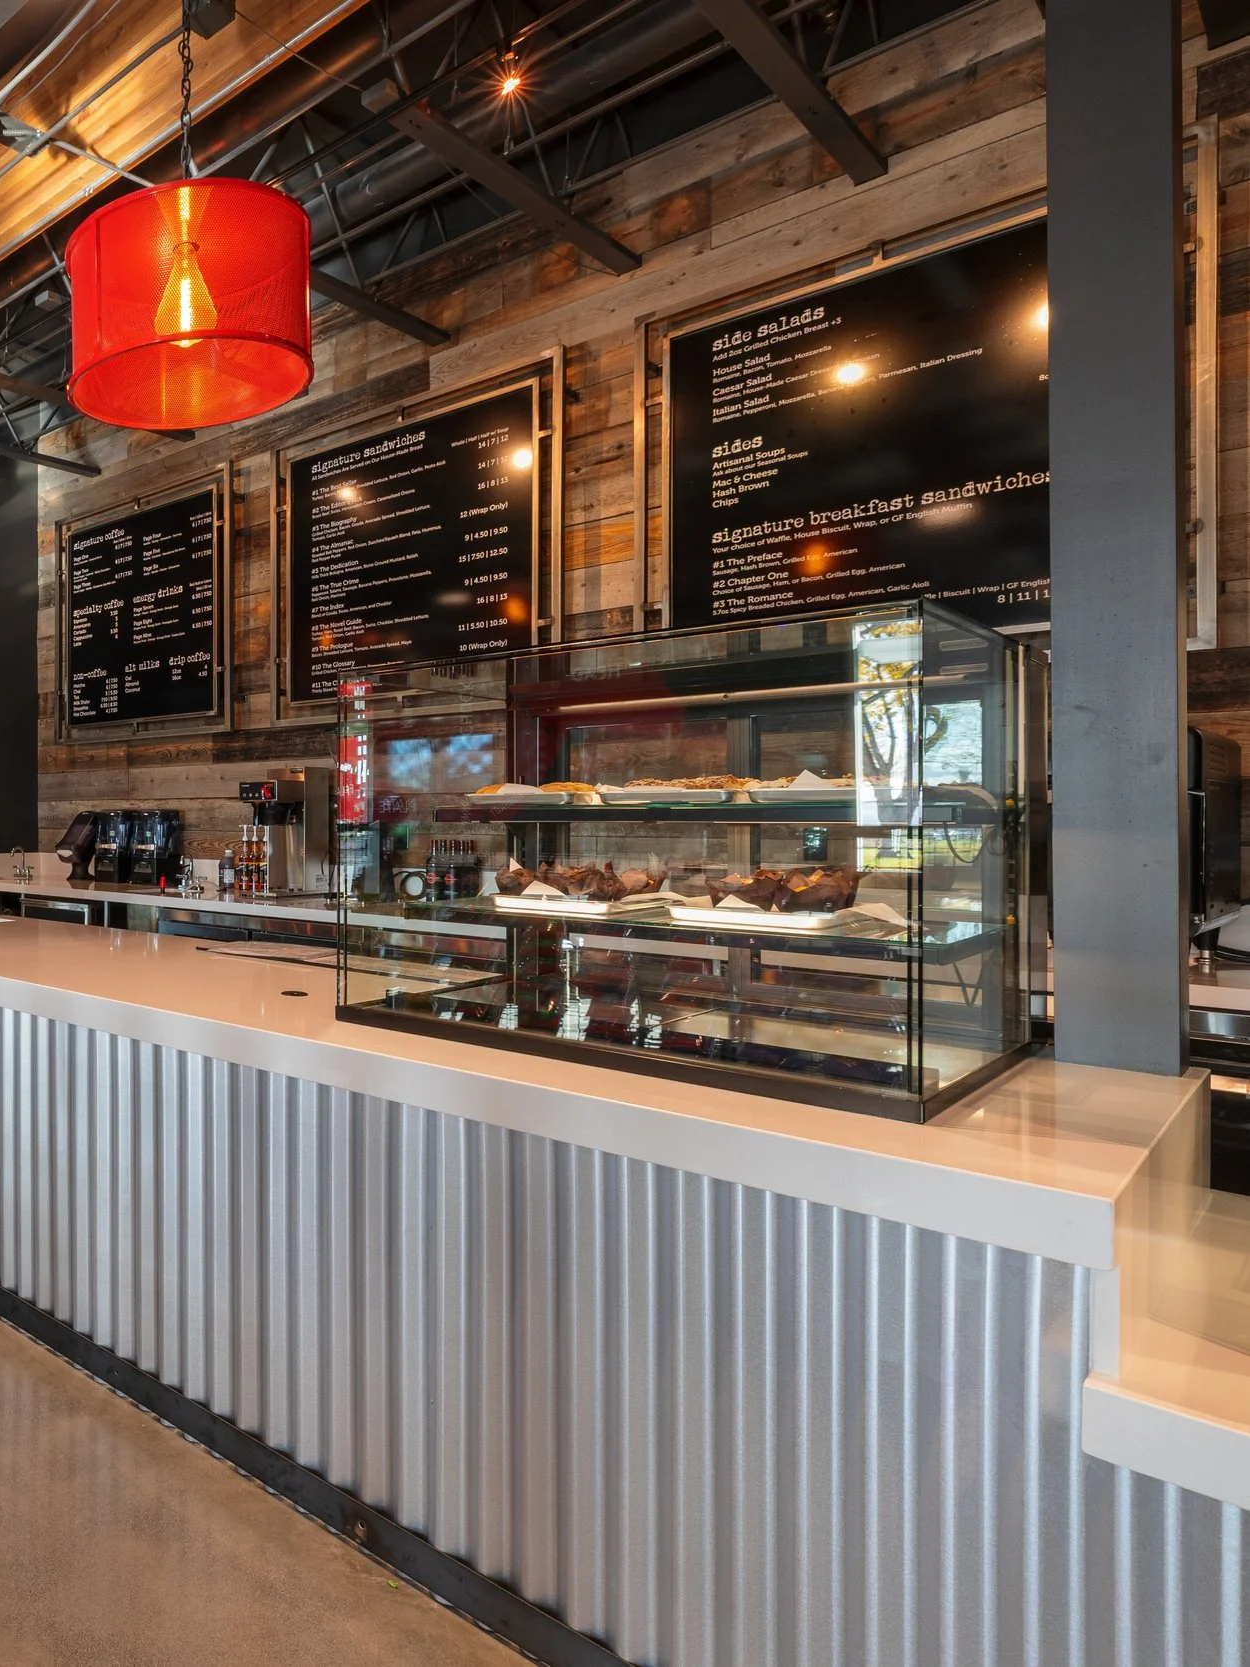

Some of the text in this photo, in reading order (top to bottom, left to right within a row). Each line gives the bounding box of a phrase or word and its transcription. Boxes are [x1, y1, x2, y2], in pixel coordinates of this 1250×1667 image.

[712, 307, 825, 351] side salads
[712, 317, 842, 362] Add 2oz Grilled Chicken Breast +3
[712, 353, 771, 376] House Salad
[712, 373, 772, 396] Caesar Salad
[712, 394, 770, 416] Italian Salad
[478, 441, 486, 449] 14
[500, 434, 509, 442] 12
[712, 436, 763, 458] sides
[311, 431, 426, 473] signature sandwiches
[712, 447, 786, 470] Artisanal Soups
[725, 465, 743, 474] about
[757, 455, 786, 467] Seasonal
[787, 451, 809, 460] Soups
[477, 482, 486, 490] 16
[500, 476, 509, 484] 13
[712, 468, 779, 488] Mac & Cheese
[712, 481, 770, 498] Hash Brown
[459, 501, 509, 518] 12 (Wrap Only)
[712, 497, 739, 508] Chips
[331, 517, 358, 527] Biography
[712, 518, 804, 543] signature
[808, 495, 914, 525] breakfast
[474, 530, 489, 538] 4.50
[493, 526, 509, 535] 9.50
[712, 546, 729, 554] Your
[730, 542, 756, 551] choice
[766, 535, 792, 544] Waffle,
[794, 530, 820, 539] House
[822, 524, 851, 534] Biscuit,
[853, 520, 878, 529] Wrap,
[891, 514, 904, 522] GF
[906, 509, 940, 520] English
[941, 503, 973, 514] Muffin
[73, 536, 104, 550] signature
[104, 529, 125, 541] coffee
[331, 539, 354, 549] Almanac
[458, 547, 508, 563] 15 7.50 12.50
[713, 552, 784, 569] #1 The Preface
[330, 560, 359, 570] Dedication
[343, 578, 359, 586] Crime
[712, 588, 734, 596] Choice
[826, 570, 850, 579] Grilled
[869, 563, 906, 573] American
[713, 572, 789, 589] #2 Chapter One
[133, 592, 156, 604] energy
[157, 585, 184, 598] drinks
[713, 592, 794, 608] #3 The Romance
[748, 602, 775, 611] Breaded
[806, 594, 830, 603] Grilled
[887, 584, 910, 592] Garlic
[912, 581, 930, 589] Aioli
[943, 589, 971, 597] Biscuit
[997, 591, 1031, 603] 8 11
[73, 604, 103, 618] specialty
[103, 599, 125, 610] coffee
[330, 620, 345, 628] Novel
[346, 618, 362, 626] Guide
[470, 621, 485, 629] 5.50
[490, 618, 508, 627] 10.50
[488, 639, 508, 648] Only)
[124, 660, 160, 673] alt milks
[168, 651, 211, 666] drip coffee
[73, 668, 107, 681] non-coffee
